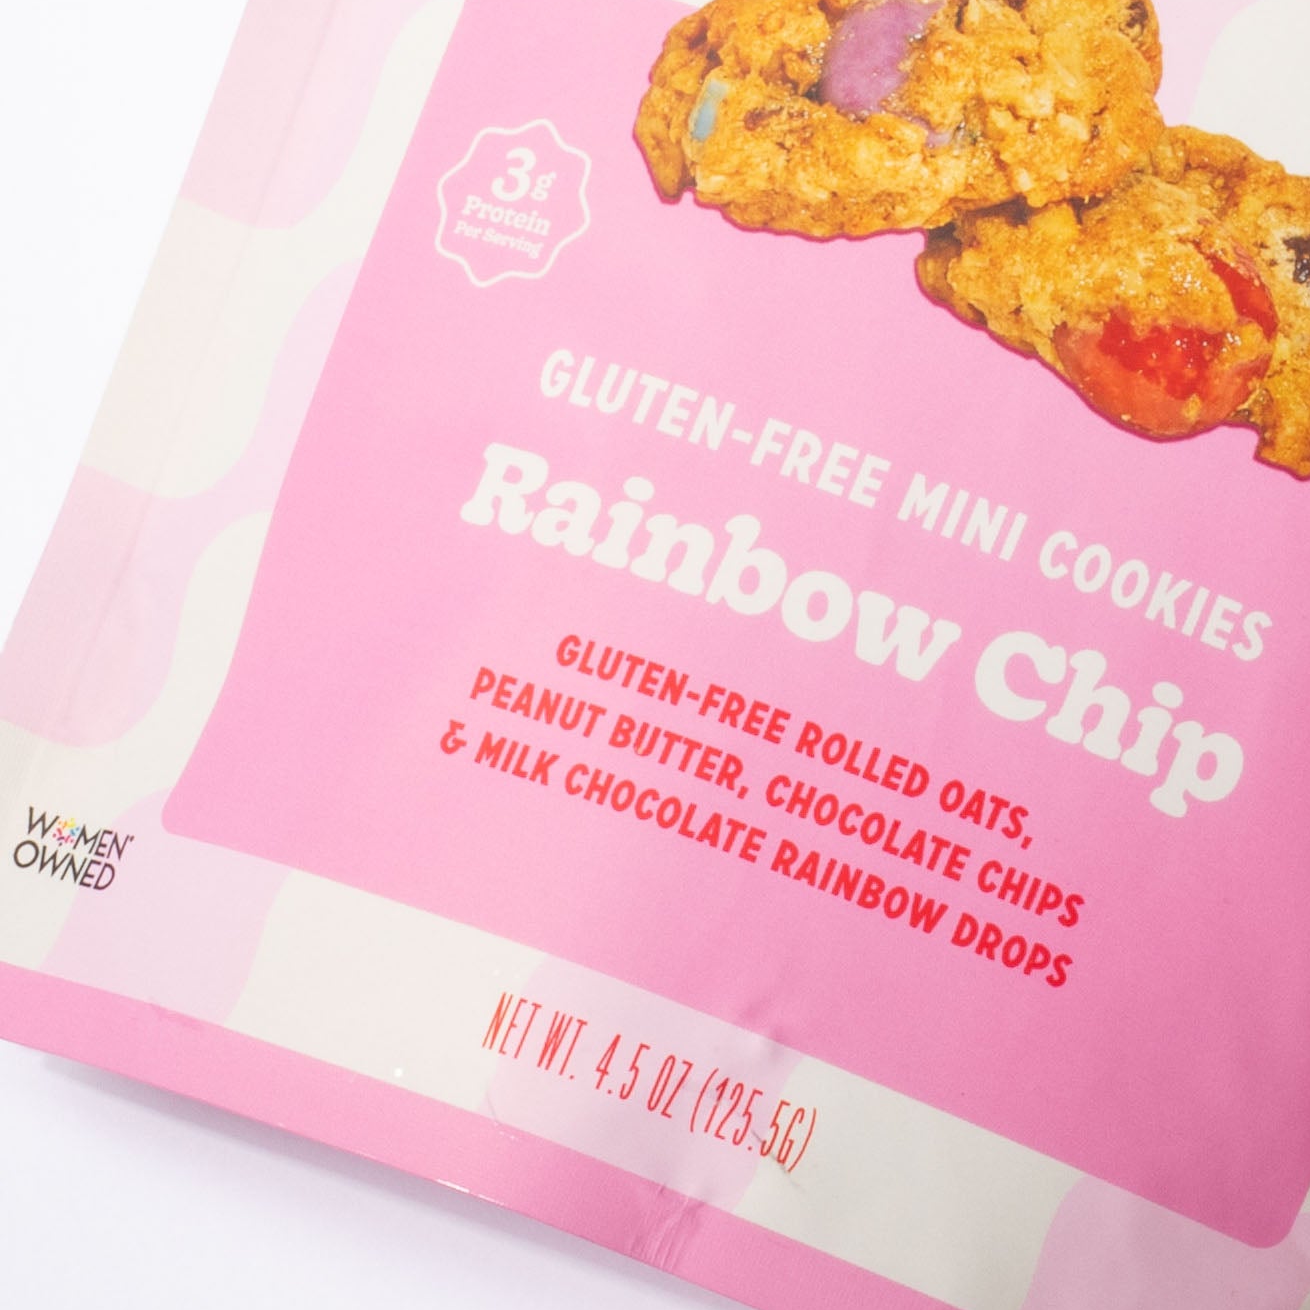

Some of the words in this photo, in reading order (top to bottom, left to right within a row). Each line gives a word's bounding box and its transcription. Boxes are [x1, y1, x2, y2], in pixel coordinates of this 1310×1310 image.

[454, 220, 482, 239] Per
[482, 228, 544, 260] Serving
[461, 195, 551, 236] Protein
[491, 147, 557, 202] 3g
[540, 348, 891, 509] GLUTEN-FREE
[897, 470, 1028, 562] MINI
[1038, 530, 1274, 662] COOKIES
[459, 442, 962, 683] Rainbow
[974, 630, 1244, 818] Chip
[470, 666, 608, 738] PEANUT
[608, 713, 749, 800] BUTTER,
[765, 774, 972, 881] CHOCOLATE
[977, 860, 1085, 928] CHIPS
[555, 634, 791, 744] GLUTEN-FREE
[795, 721, 930, 798] ROLLED
[939, 779, 1033, 850] OATS,
[13, 840, 115, 891] OWNED
[439, 719, 467, 755] &
[474, 730, 560, 786] MILK
[564, 762, 767, 864] CHOCOLATE
[770, 839, 949, 934] RAINBOW
[950, 912, 1073, 988] DROPS
[481, 991, 543, 1060] NET
[537, 1011, 588, 1080] WT.
[595, 1033, 650, 1100] 4.5
[647, 1054, 694, 1119] OZ
[689, 1067, 817, 1174] (125.5G)
